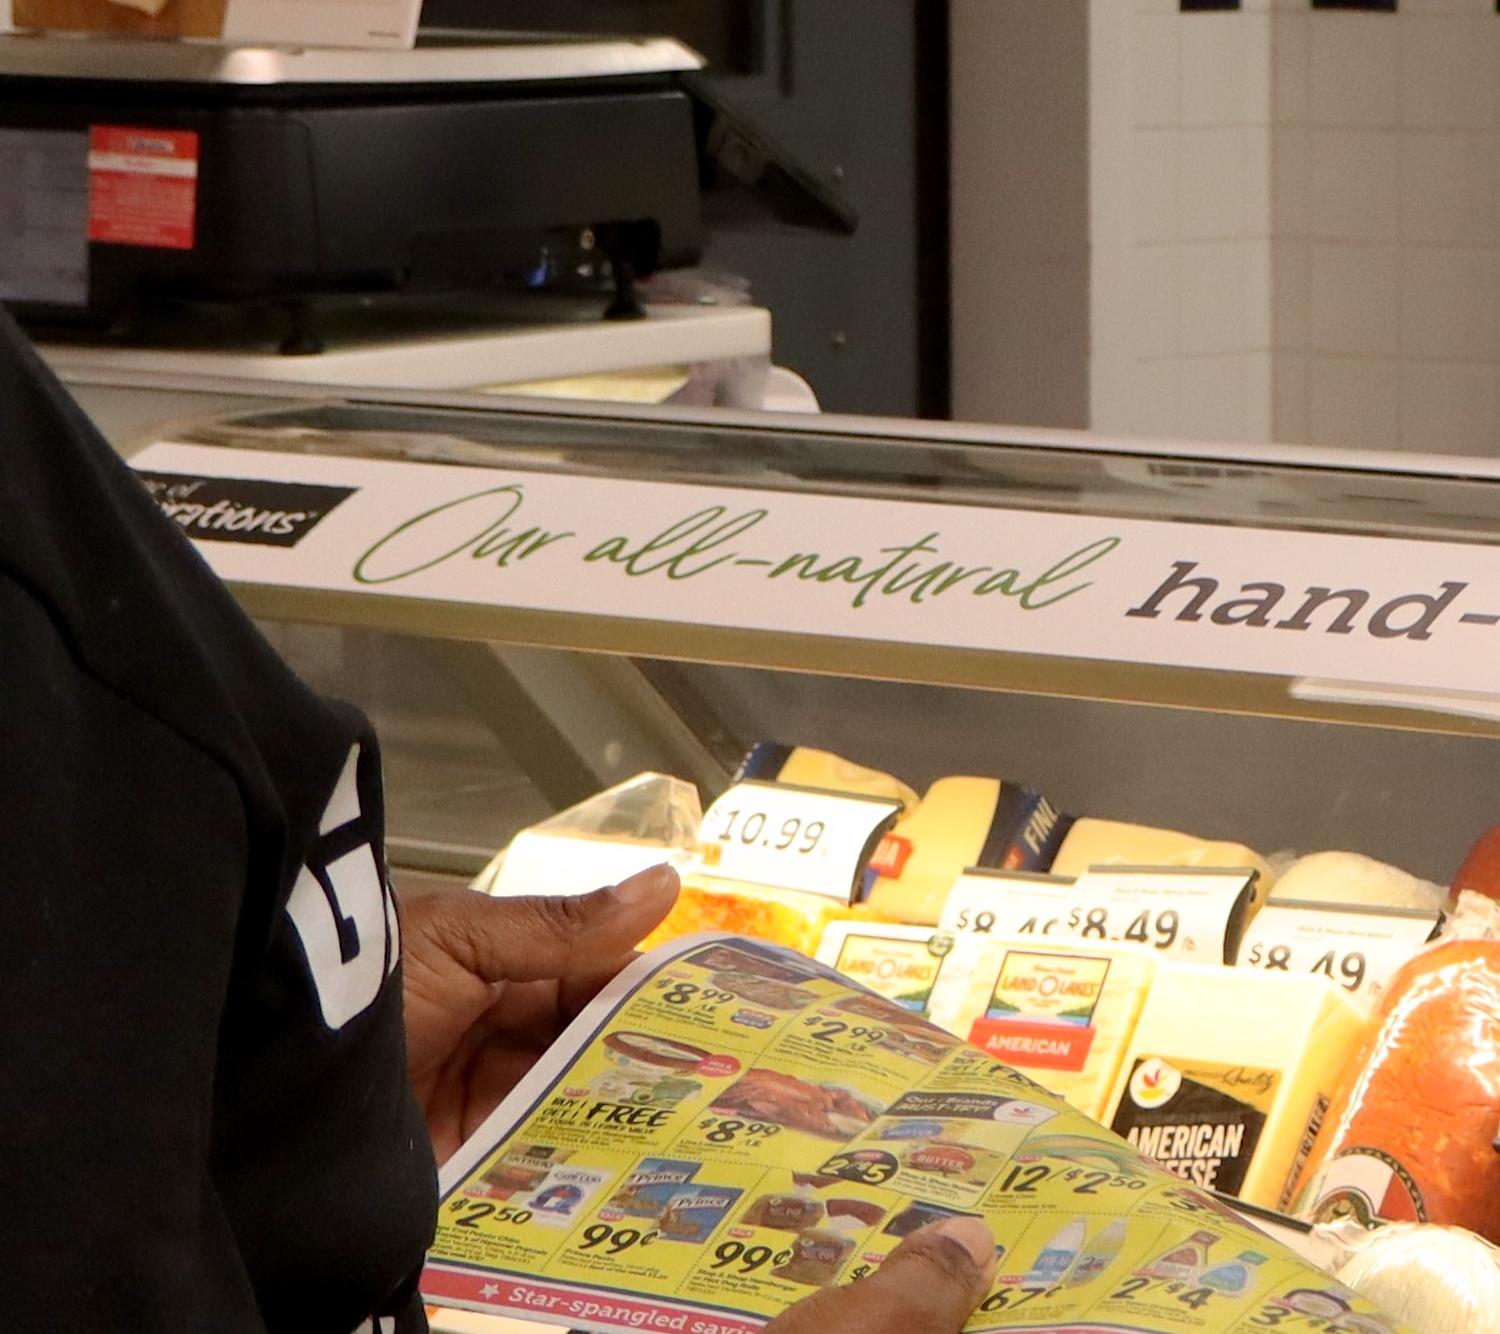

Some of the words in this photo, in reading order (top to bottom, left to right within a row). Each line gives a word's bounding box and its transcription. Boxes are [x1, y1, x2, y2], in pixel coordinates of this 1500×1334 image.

[352, 483, 574, 585] Our
[585, 505, 1122, 611] all-natural
[709, 803, 828, 857] $10.99
[1002, 972, 1037, 995] LAND
[1060, 978, 1099, 1001] LAKES
[986, 1033, 1072, 1058] AMERICAN
[584, 1101, 678, 1128] FREE
[1125, 1122, 1246, 1160] AMERICAN
[507, 1286, 688, 1332] Star-spangled
